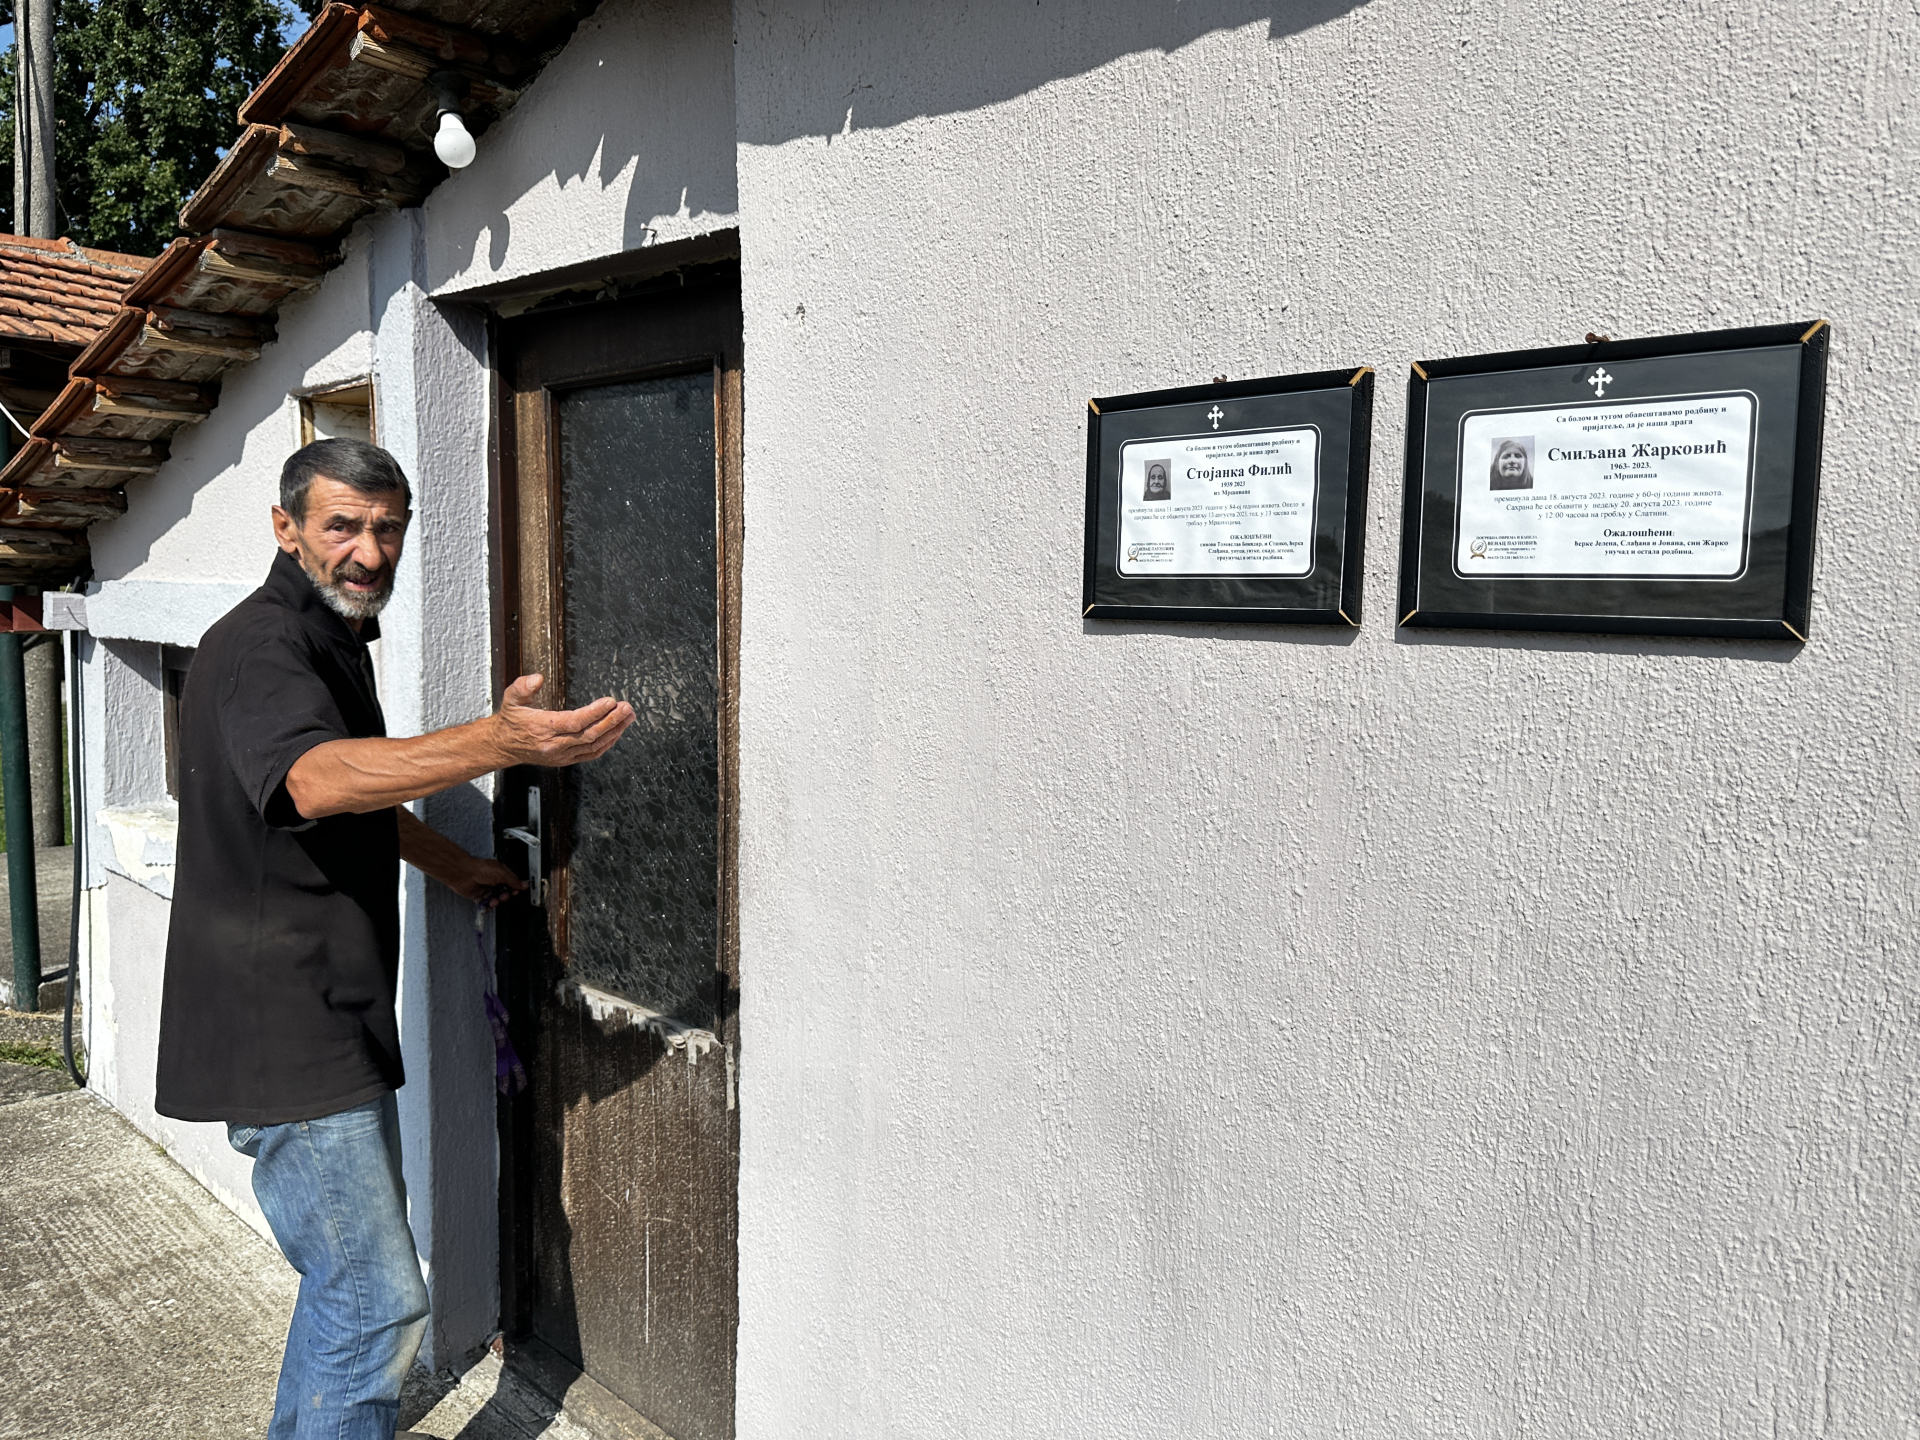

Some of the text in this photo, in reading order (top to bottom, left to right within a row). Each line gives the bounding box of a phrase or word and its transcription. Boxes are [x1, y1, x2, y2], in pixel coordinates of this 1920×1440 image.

[1556, 415, 1567, 423] Са
[1568, 414, 1592, 422] болом
[1600, 413, 1623, 421] тугом
[1625, 409, 1683, 419] обавештавамо
[1685, 407, 1719, 417] родбину
[1582, 422, 1625, 432] пријатеље,
[1670, 418, 1693, 427] драга
[1547, 440, 1727, 462] Смиљана Жарковић
[1632, 461, 1652, 469] 2023.
[1186, 462, 1292, 482] Стојанка Филић
[1561, 493, 1587, 502] августа
[1589, 492, 1608, 500] 2023.
[1609, 492, 1635, 500] године
[1642, 490, 1661, 499] 60-ој
[1662, 490, 1690, 498] години
[1506, 503, 1534, 512] Сахрана
[1553, 502, 1582, 510] обавити
[1592, 502, 1618, 510] недељу
[1620, 500, 1631, 509] 20.
[1632, 500, 1660, 509] августа
[1662, 500, 1682, 508] 2023.
[1685, 500, 1712, 508] године
[1545, 511, 1564, 519] 12:00
[1600, 511, 1626, 520] гробљу
[1634, 509, 1669, 517] Слатини.
[1702, 539, 1729, 547] Жарко
[1662, 548, 1694, 556] родбина.
